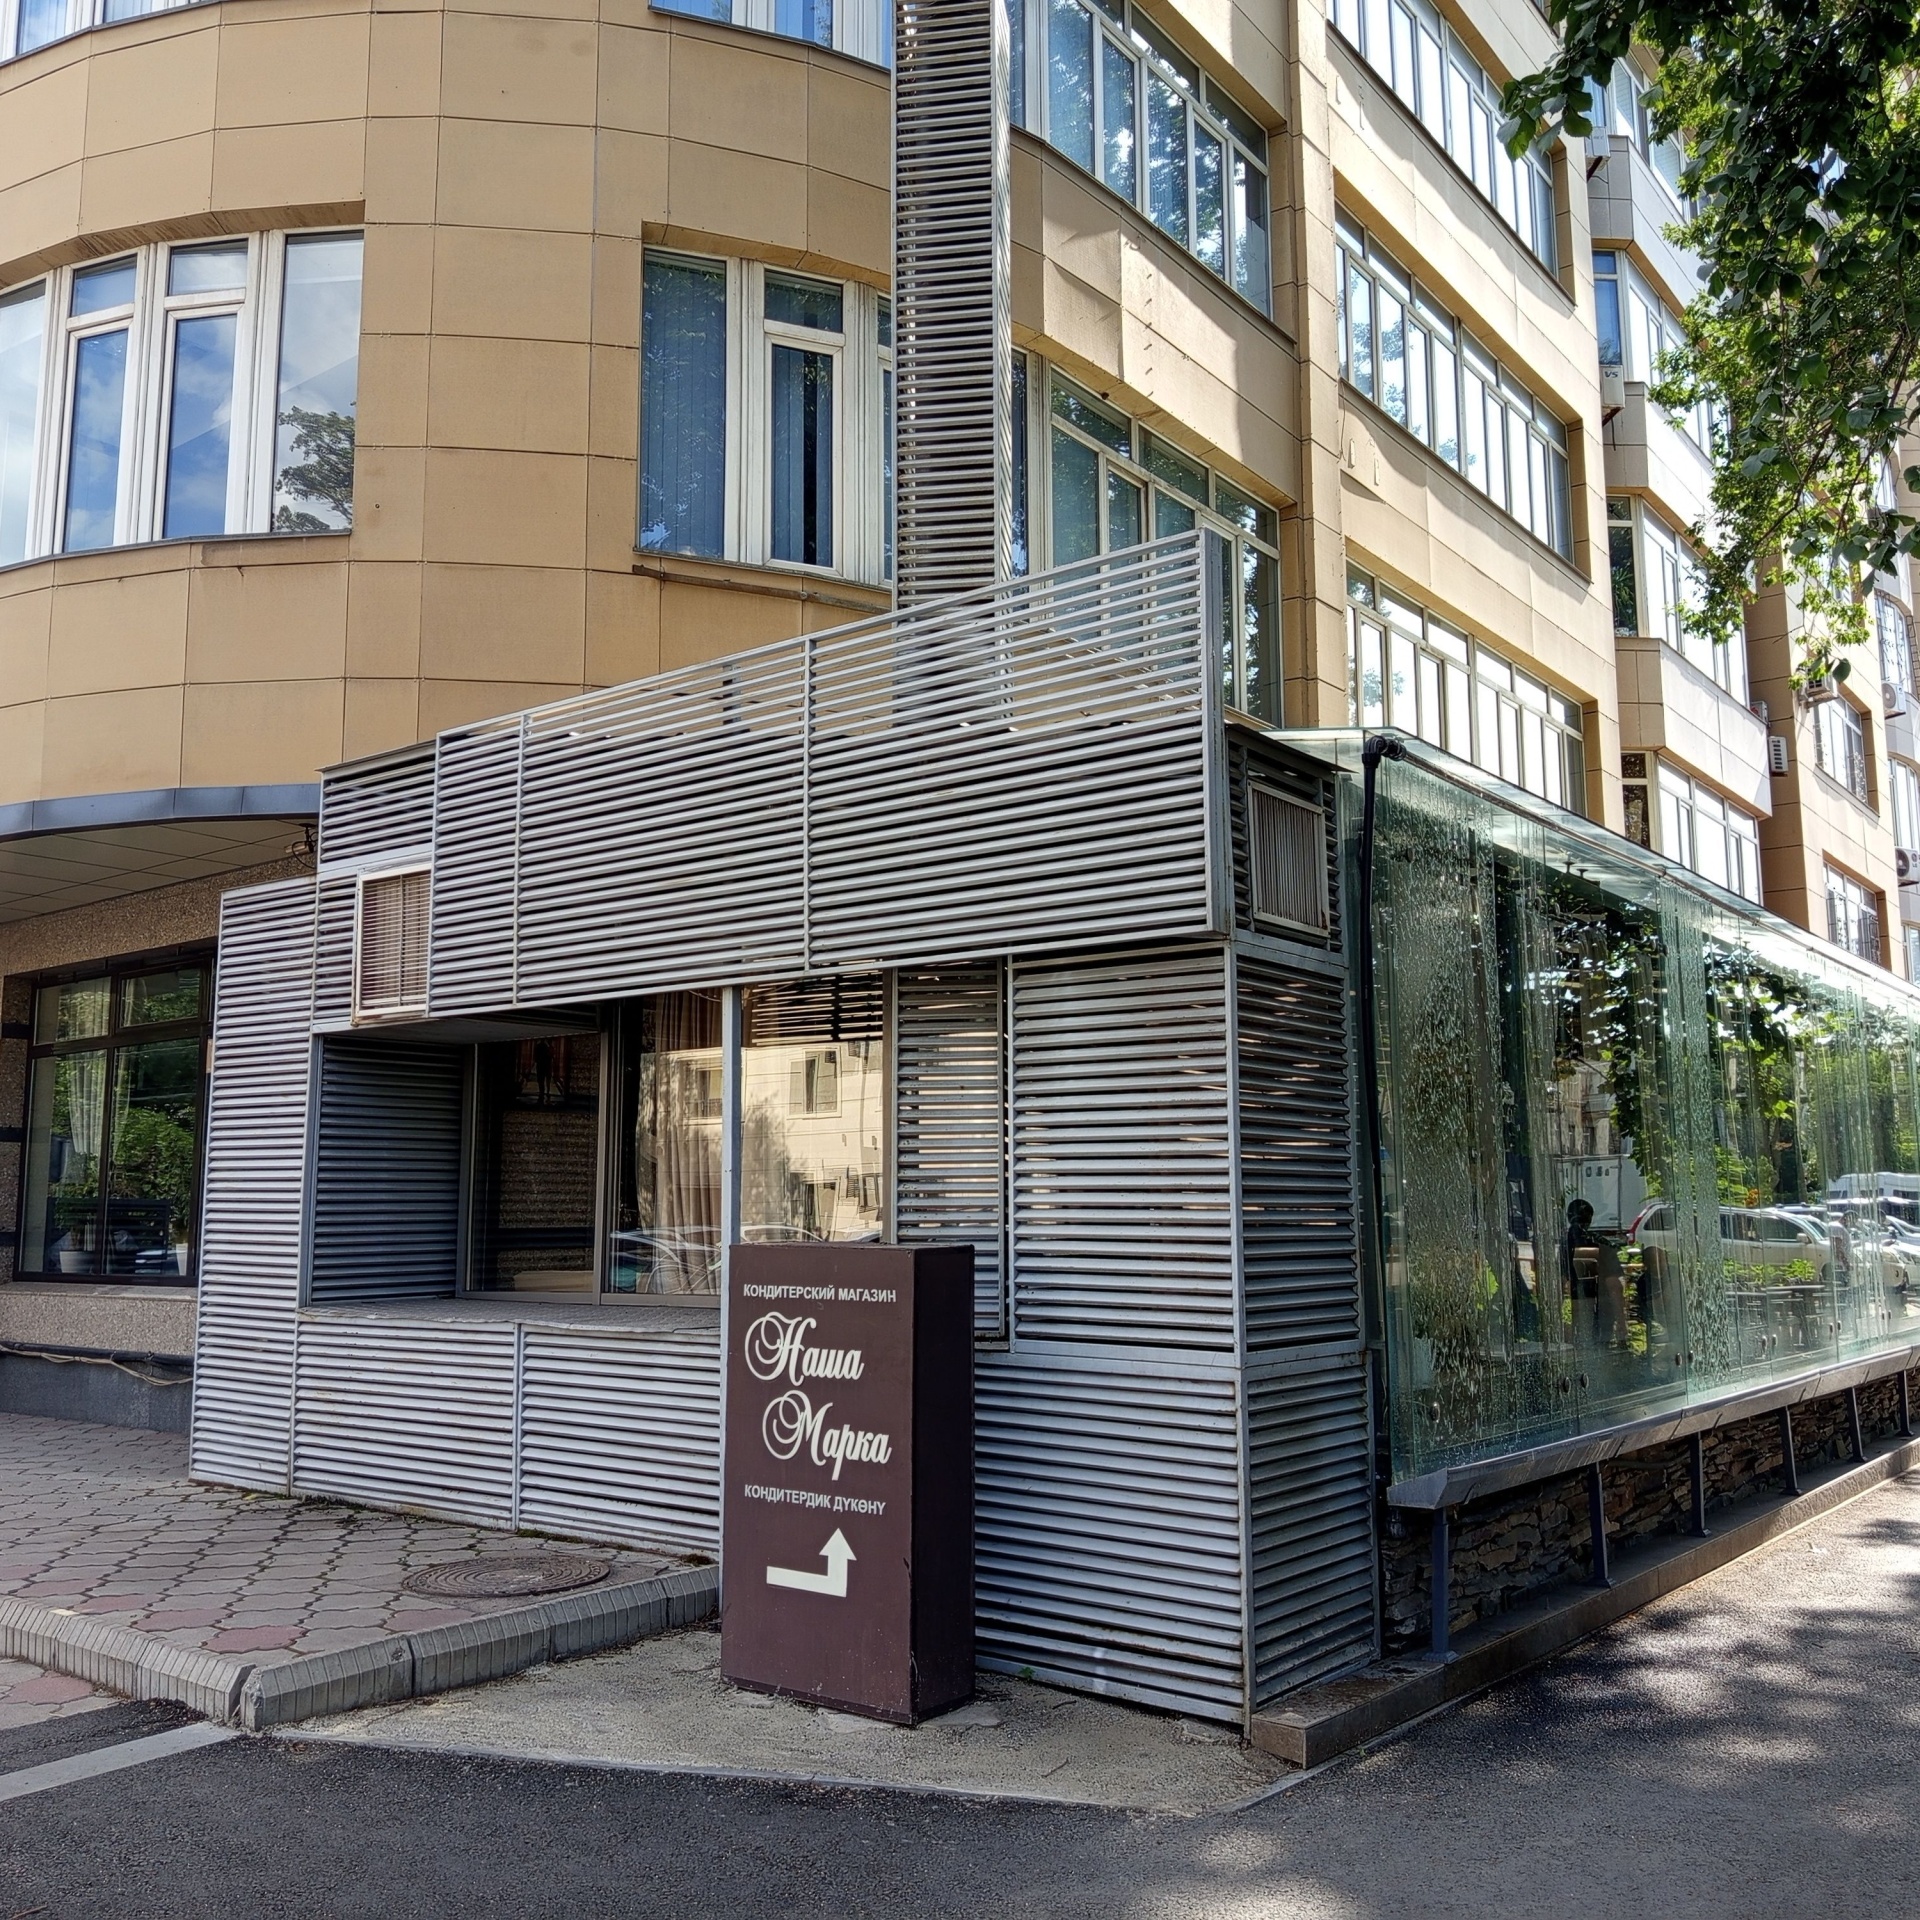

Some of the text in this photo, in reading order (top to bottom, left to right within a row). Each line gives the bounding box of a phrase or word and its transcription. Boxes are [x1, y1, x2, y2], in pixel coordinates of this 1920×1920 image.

[743, 1284, 897, 1303] КОНДИТЕРСКИЙ МАГАЗИН
[744, 1311, 865, 1386] Наша
[762, 1389, 893, 1481] Марка
[744, 1484, 886, 1515] КОНДИТЕРДИК ДҮКӨНҮ
